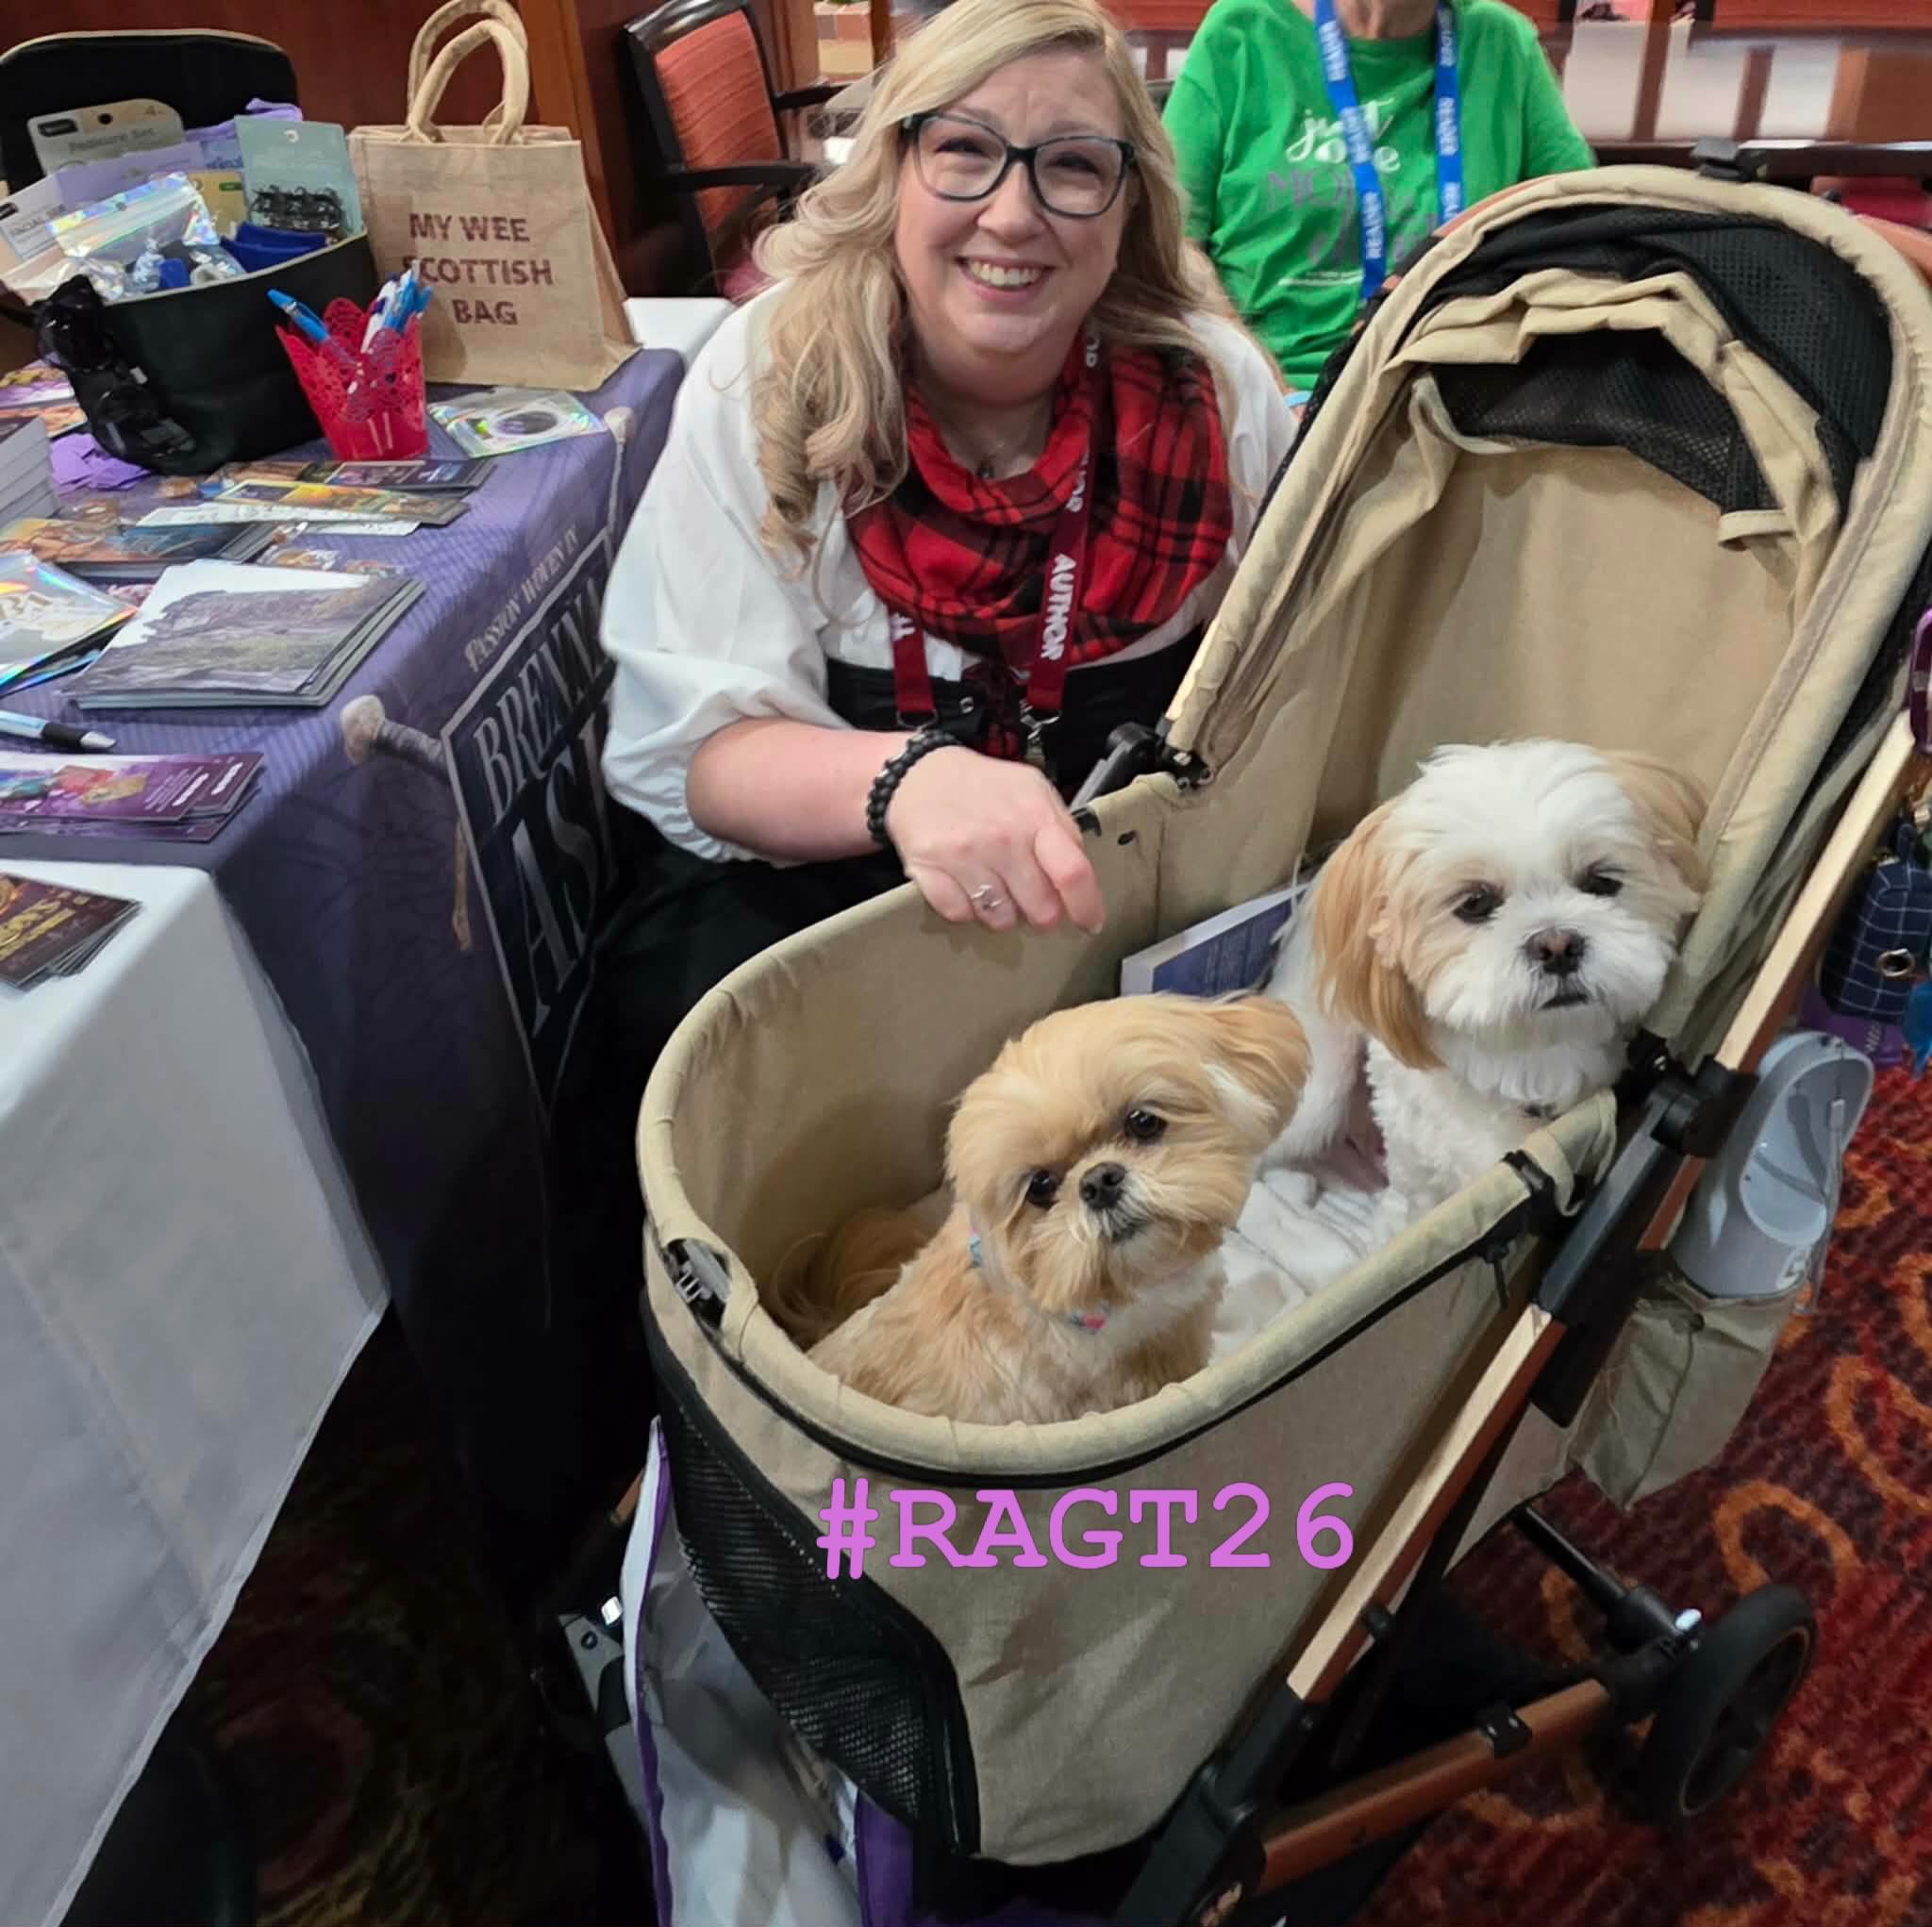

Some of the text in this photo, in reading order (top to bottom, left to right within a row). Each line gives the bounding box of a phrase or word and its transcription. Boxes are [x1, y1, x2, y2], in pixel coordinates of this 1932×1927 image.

[408, 213, 531, 242] MY WEE
[452, 299, 518, 325] BAG
[1041, 553, 1077, 660] AUTHOR
